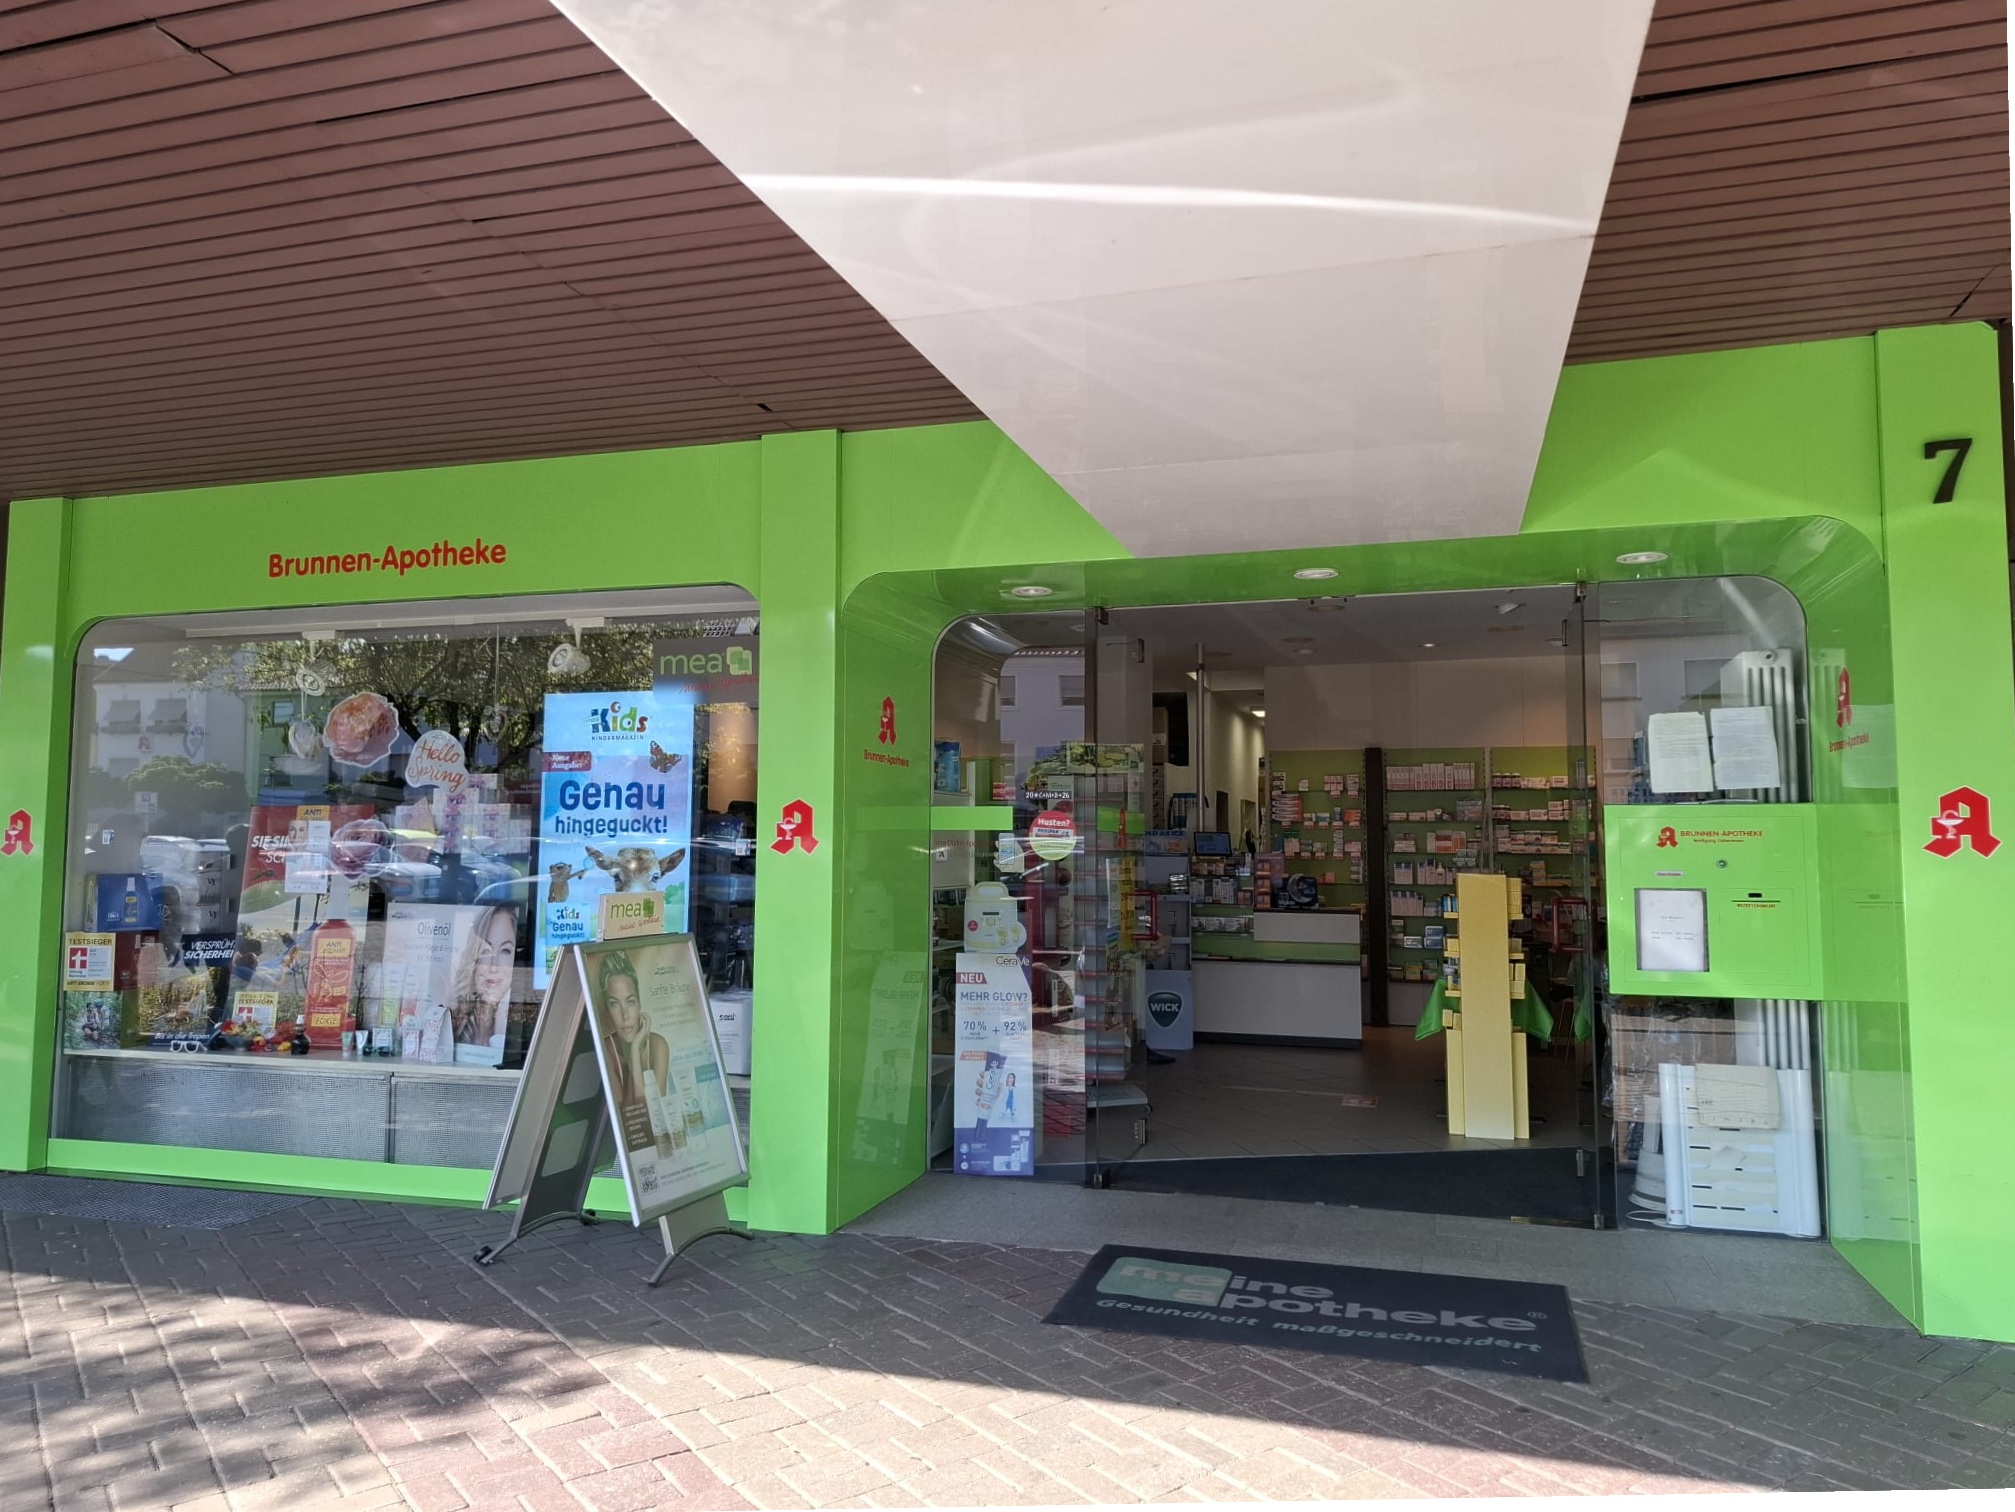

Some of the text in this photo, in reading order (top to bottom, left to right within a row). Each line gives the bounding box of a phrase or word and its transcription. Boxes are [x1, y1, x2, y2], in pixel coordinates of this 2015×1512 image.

[1924, 438, 1973, 504] 7
[268, 537, 507, 578] Brunnen-Apotheke
[660, 652, 723, 675] mea
[415, 739, 461, 764] Hello
[407, 756, 467, 793] Spring
[559, 779, 666, 811] Genau
[555, 815, 668, 839] hingeguckt!
[1037, 818, 1070, 828] Husten?
[610, 902, 641, 919] mea
[417, 921, 451, 937] Olivenöl
[552, 922, 584, 932] Genau
[995, 955, 1030, 966] CeraVe
[960, 973, 983, 983] NEU
[960, 992, 1028, 1002] MEHR GLOW?
[1150, 1003, 1179, 1012] WICK
[963, 1021, 976, 1031] 70
[1003, 1021, 1016, 1031] 92
[188, 1032, 210, 1041] Tropen
[1119, 1265, 1334, 1298] meine
[1272, 1321, 1542, 1353] maßgeschneidert
